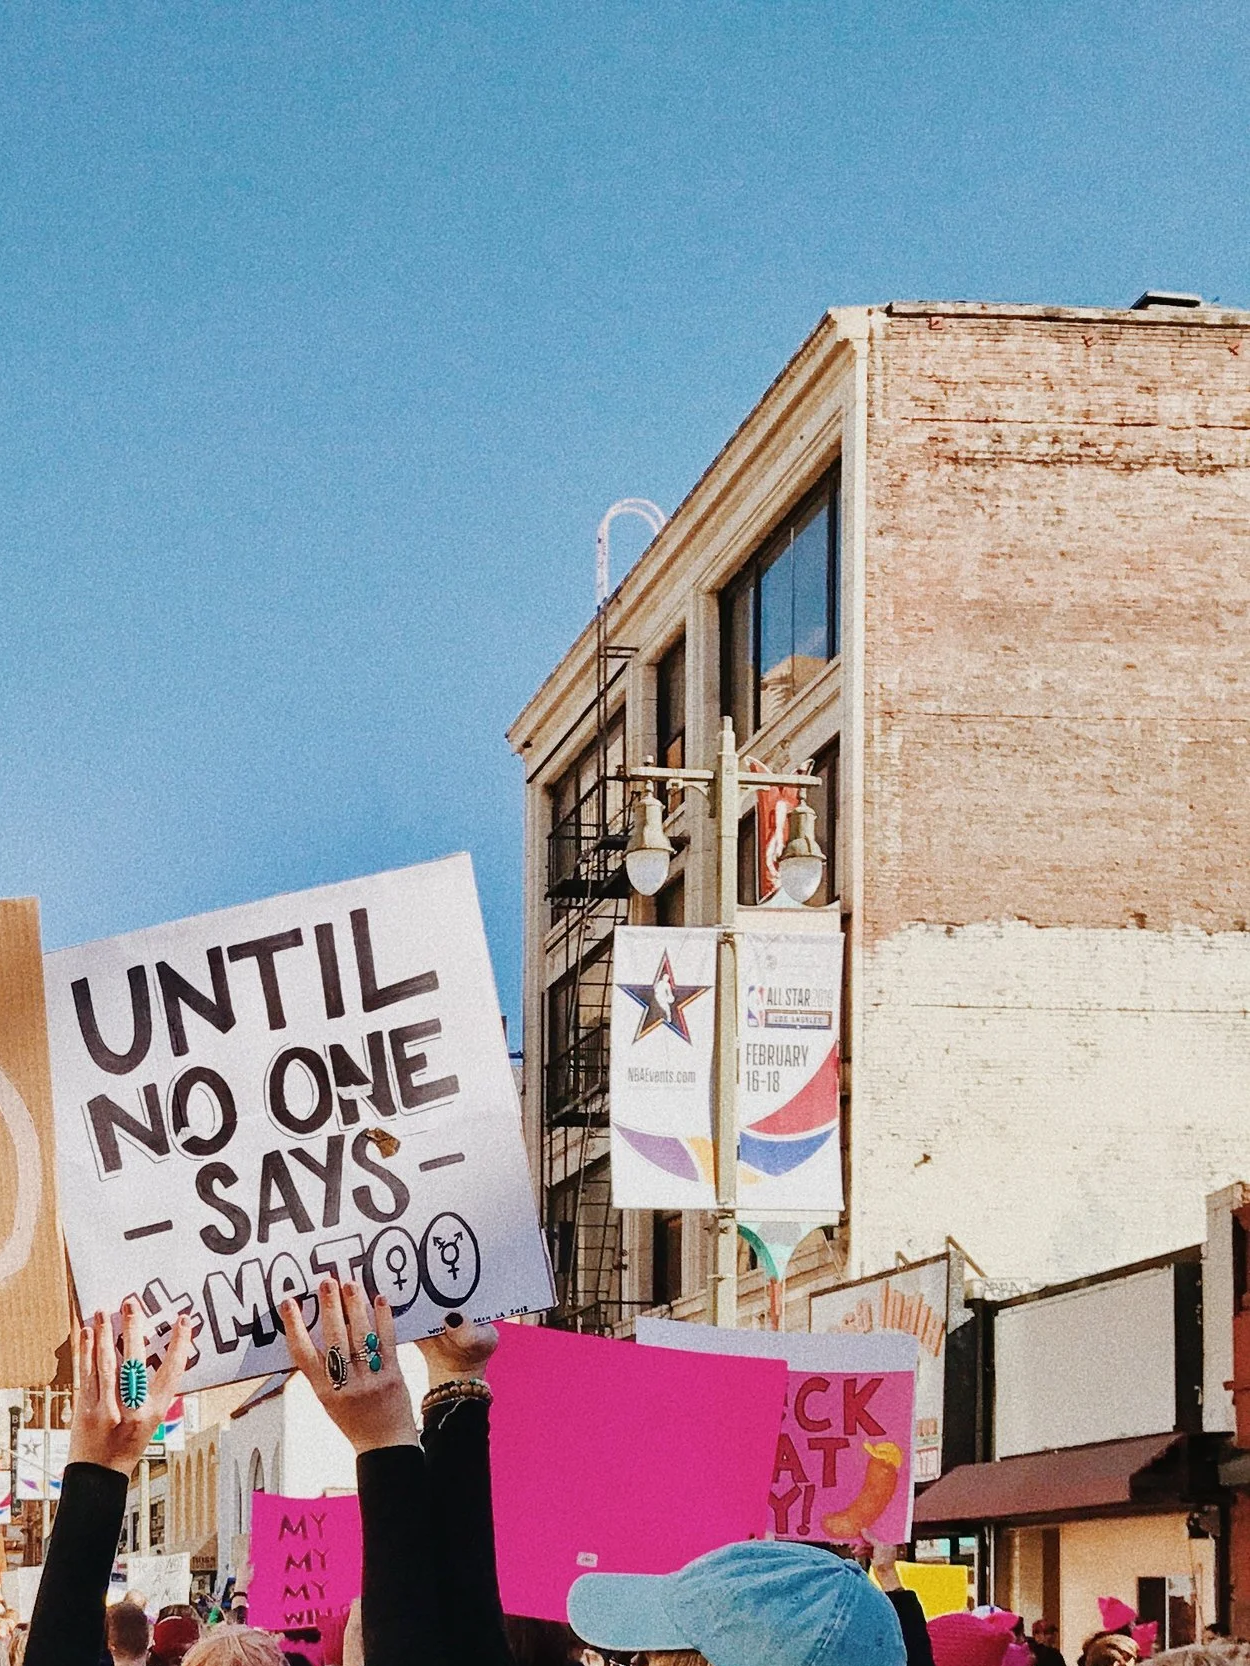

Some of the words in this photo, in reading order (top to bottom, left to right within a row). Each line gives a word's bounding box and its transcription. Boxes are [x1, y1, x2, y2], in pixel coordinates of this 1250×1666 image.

[70, 908, 440, 1076] UNTIL
[766, 986, 784, 1006] ALL
[785, 988, 811, 1007] STAR
[746, 1043, 810, 1067] FEBRUARY
[627, 1067, 697, 1084] NBAEvents.com
[746, 1070, 781, 1093] 16-18
[82, 1064, 239, 1181] NO
[265, 1018, 461, 1134] ONE
[194, 1129, 412, 1256] SAYS
[278, 1512, 327, 1541] MY
[285, 1548, 330, 1573] MY
[282, 1580, 330, 1602] MY
